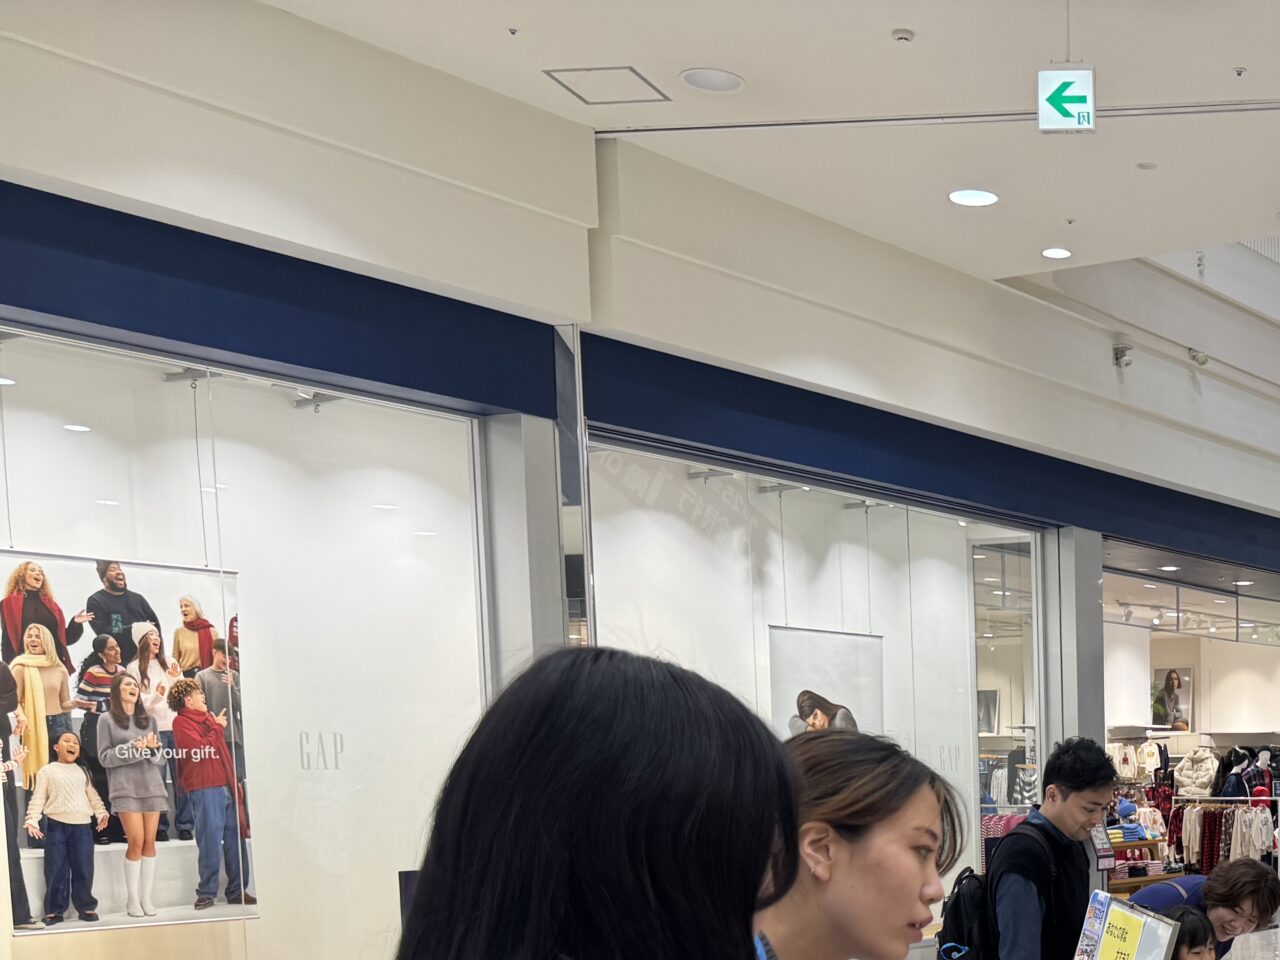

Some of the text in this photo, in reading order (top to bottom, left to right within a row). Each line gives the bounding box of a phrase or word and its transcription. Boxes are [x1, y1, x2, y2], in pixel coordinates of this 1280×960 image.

[115, 744, 220, 763] Give your gift.
[299, 732, 345, 771] GAP
